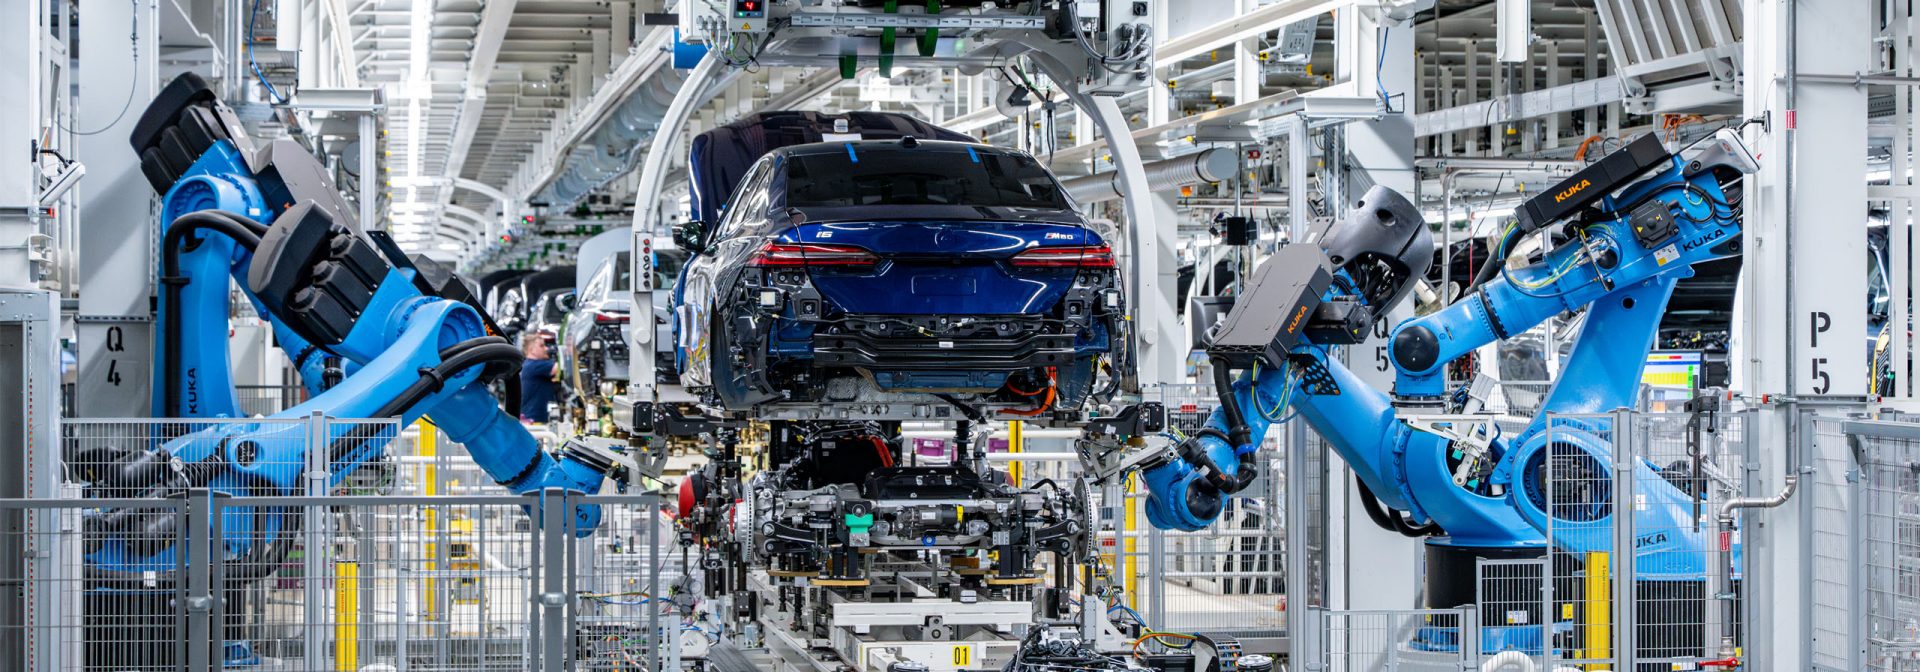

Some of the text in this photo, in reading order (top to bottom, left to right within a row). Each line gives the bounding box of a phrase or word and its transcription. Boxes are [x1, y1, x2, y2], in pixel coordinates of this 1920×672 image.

[745, 1, 754, 10] 4
[1554, 179, 1592, 204] KUKA
[1682, 228, 1726, 252] KUKA
[1287, 305, 1308, 334] KUKA
[1374, 317, 1389, 339] Q
[1810, 311, 1832, 348] P
[106, 326, 124, 352] Q
[1375, 346, 1389, 372] 5
[107, 359, 121, 386] 4
[1811, 358, 1831, 395] 5
[188, 367, 198, 414] KUKA
[954, 646, 967, 665] 01
